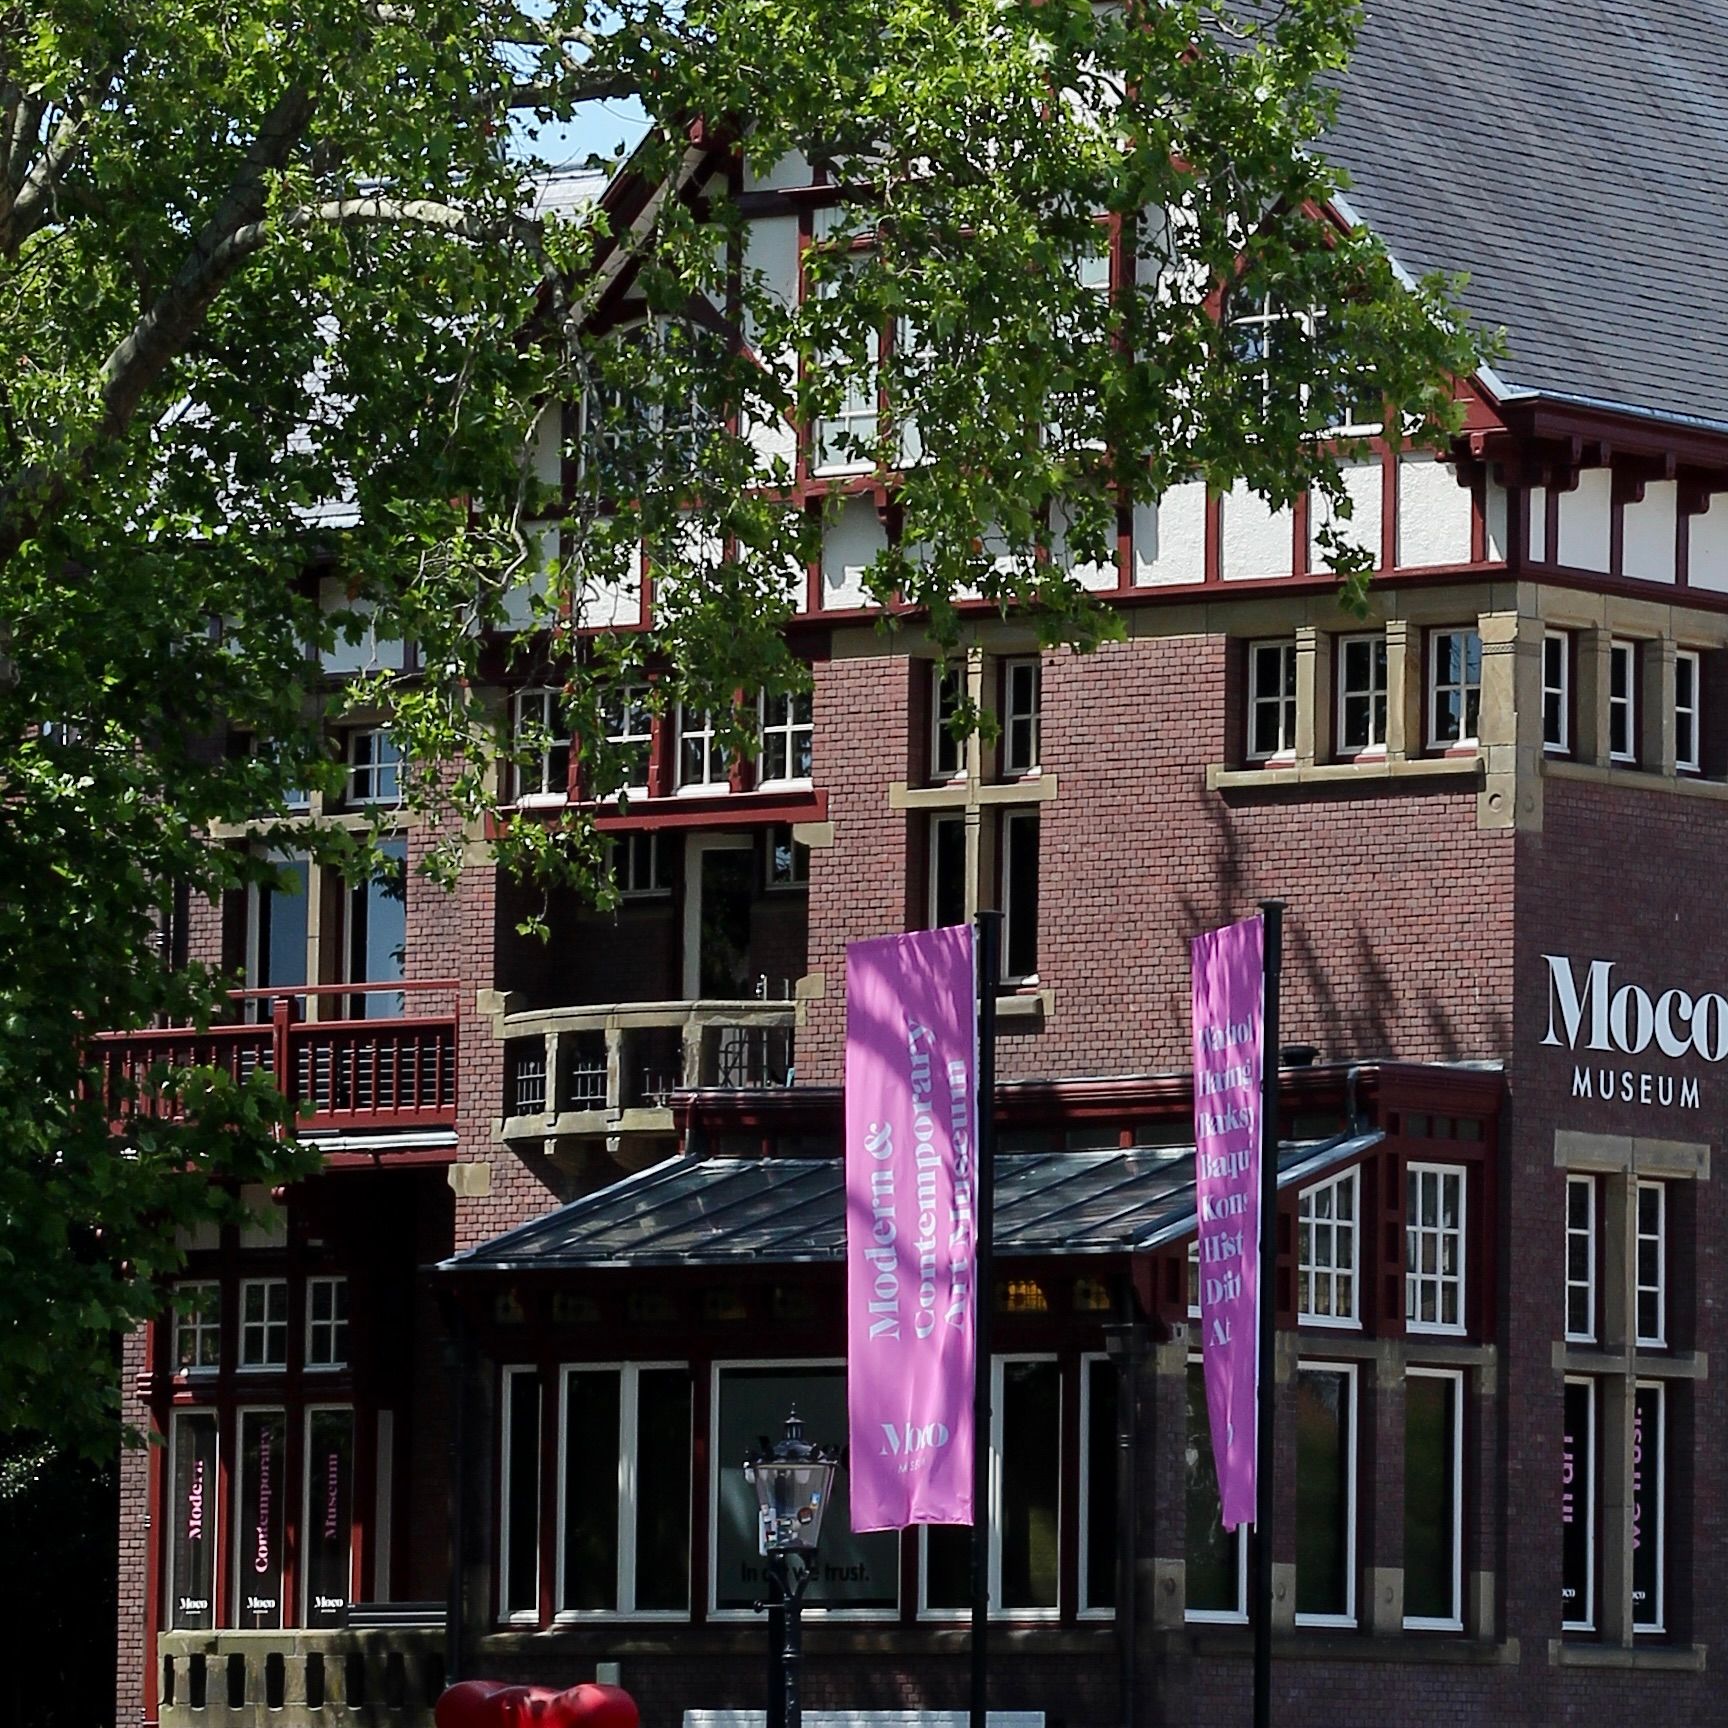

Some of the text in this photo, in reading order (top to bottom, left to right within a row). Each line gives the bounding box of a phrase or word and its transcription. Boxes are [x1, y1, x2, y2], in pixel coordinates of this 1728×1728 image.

[1571, 1065, 1701, 1109] MUSEUM
[908, 1015, 942, 1340] Contemporary
[864, 1121, 901, 1342] Modern &
[944, 1256, 969, 1333] Art
[179, 1597, 208, 1610] Moco
[246, 1596, 276, 1610] Moco
[313, 1595, 344, 1609] Moco
